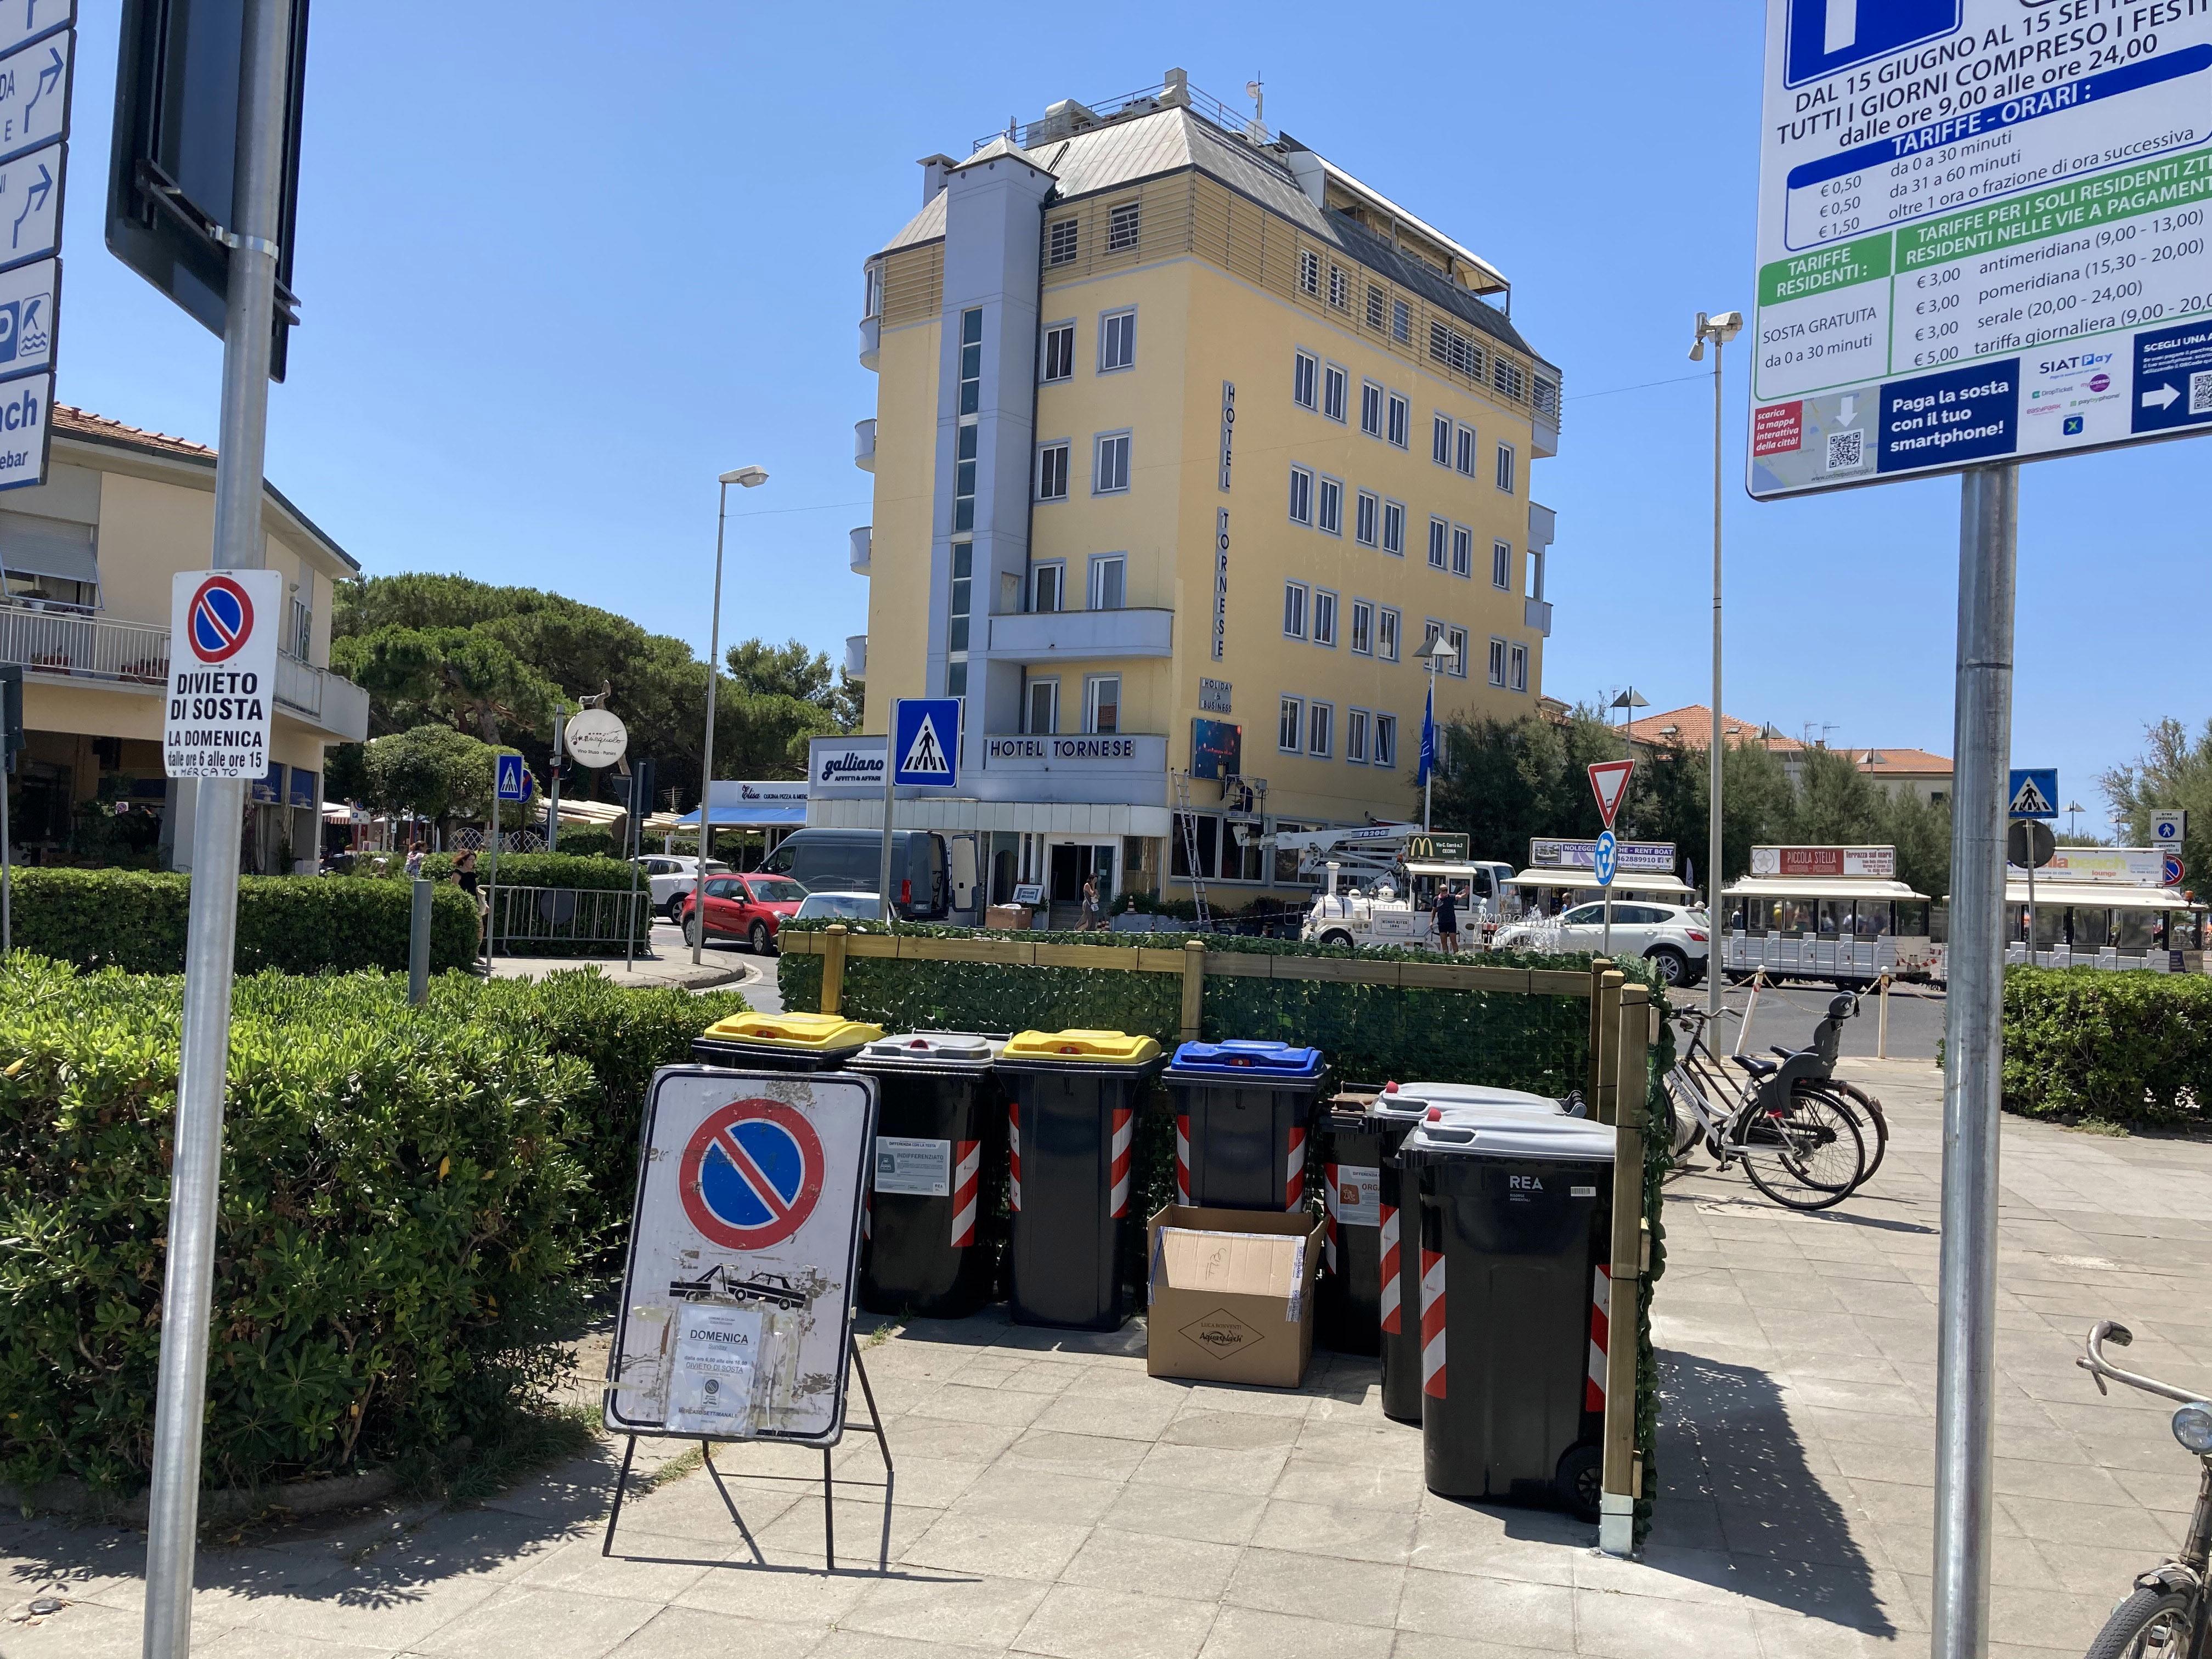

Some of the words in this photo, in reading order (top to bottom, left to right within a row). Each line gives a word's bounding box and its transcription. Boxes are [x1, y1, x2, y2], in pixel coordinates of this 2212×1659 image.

[1777, 107, 1841, 145] TUTTI
[1861, 71, 1948, 117] GIORNI
[1956, 22, 2107, 86] COMPRESO
[1796, 84, 1838, 113] DAL
[1878, 36, 1975, 83] GIUGNO
[1839, 119, 1890, 146] dalle
[1897, 107, 1932, 129] ore
[1939, 86, 1986, 116] 9,00
[1994, 73, 2035, 99] alle
[2042, 60, 2081, 83] ore
[2089, 33, 2157, 70] 24,00
[1892, 112, 1982, 156] TARIFFE
[2002, 83, 2078, 125] ORARI
[1961, 129, 2012, 157] minuti
[1889, 199, 1923, 219] oltre
[1939, 190, 1964, 206] ora
[1983, 165, 2047, 194] frazione
[2072, 152, 2099, 170] ora
[2104, 128, 2194, 162] successiva
[1970, 149, 2021, 177] minuti
[1832, 175, 1861, 194] 0,50
[1831, 196, 1860, 215] 0,50
[1917, 213, 1983, 243] TARIFFE
[2034, 189, 2075, 214] SOLI
[2080, 162, 2178, 203] RESIDENTI
[1831, 217, 1860, 236] 1,50
[1906, 233, 1993, 266] RESIDENTI
[1997, 215, 2052, 242] NELLE
[1979, 238, 2091, 274] antimeridiana
[2153, 208, 2204, 234] 13,00)
[1788, 247, 1851, 276] TARIFFE
[1979, 268, 2080, 304] pomeridiana
[2085, 253, 2136, 279] (15,30
[2151, 238, 2204, 263] 20,00)
[1776, 264, 1859, 297] RESIDENTI
[1930, 267, 1961, 287] 3,00
[1928, 294, 1960, 313] 3,00
[1978, 307, 2023, 329] serale
[2028, 295, 2077, 320] (20,00
[2091, 279, 2142, 304] 24,00)
[1763, 323, 1805, 345] SOSTA
[1809, 307, 1877, 334] GRATUITA
[1928, 321, 1959, 340] 3,00
[1974, 334, 2021, 354] tariffa
[2025, 315, 2115, 347] giornaliera
[1827, 333, 1872, 355] minuti
[2143, 338, 2181, 353] SCEGLI
[2183, 334, 2207, 345] UNA
[2039, 356, 2080, 374] SIAT
[1892, 395, 1936, 413] Paga
[1959, 381, 2009, 400] sosta
[1757, 409, 1785, 420] scarica
[1766, 417, 1795, 430] mappa
[1223, 385, 1235, 488] HOTEL
[1757, 427, 1799, 441] interattiva
[1890, 420, 2004, 452] smartphone!
[1756, 441, 1776, 452] della
[1214, 512, 1229, 657] TORNESE
[177, 672, 258, 695] DIVIETO
[1203, 678, 1233, 692] HOLIDAY
[171, 698, 187, 721] DI
[193, 697, 263, 721] SOSTA
[1201, 700, 1232, 713] BUSINESS
[168, 730, 181, 747] LA
[184, 730, 263, 748] DOMENICA
[990, 740, 1045, 757] HOTEL
[1053, 740, 1133, 757] TORNESE
[168, 751, 184, 767] dalle
[185, 753, 197, 767] ore
[199, 751, 205, 767] 6
[207, 751, 226, 768] alle
[229, 754, 246, 768] ore
[249, 751, 262, 768] 15
[822, 752, 884, 781] galliano
[180, 768, 239, 777] MERCATO
[1787, 851, 1813, 864] PICCOLA
[1814, 851, 1837, 864] STELLA
[1509, 1175, 1544, 1190] REA
[690, 1329, 749, 1344] DOMENICA
[686, 1362, 712, 1370] DIVIETO
[721, 1365, 744, 1374] SOSTA
